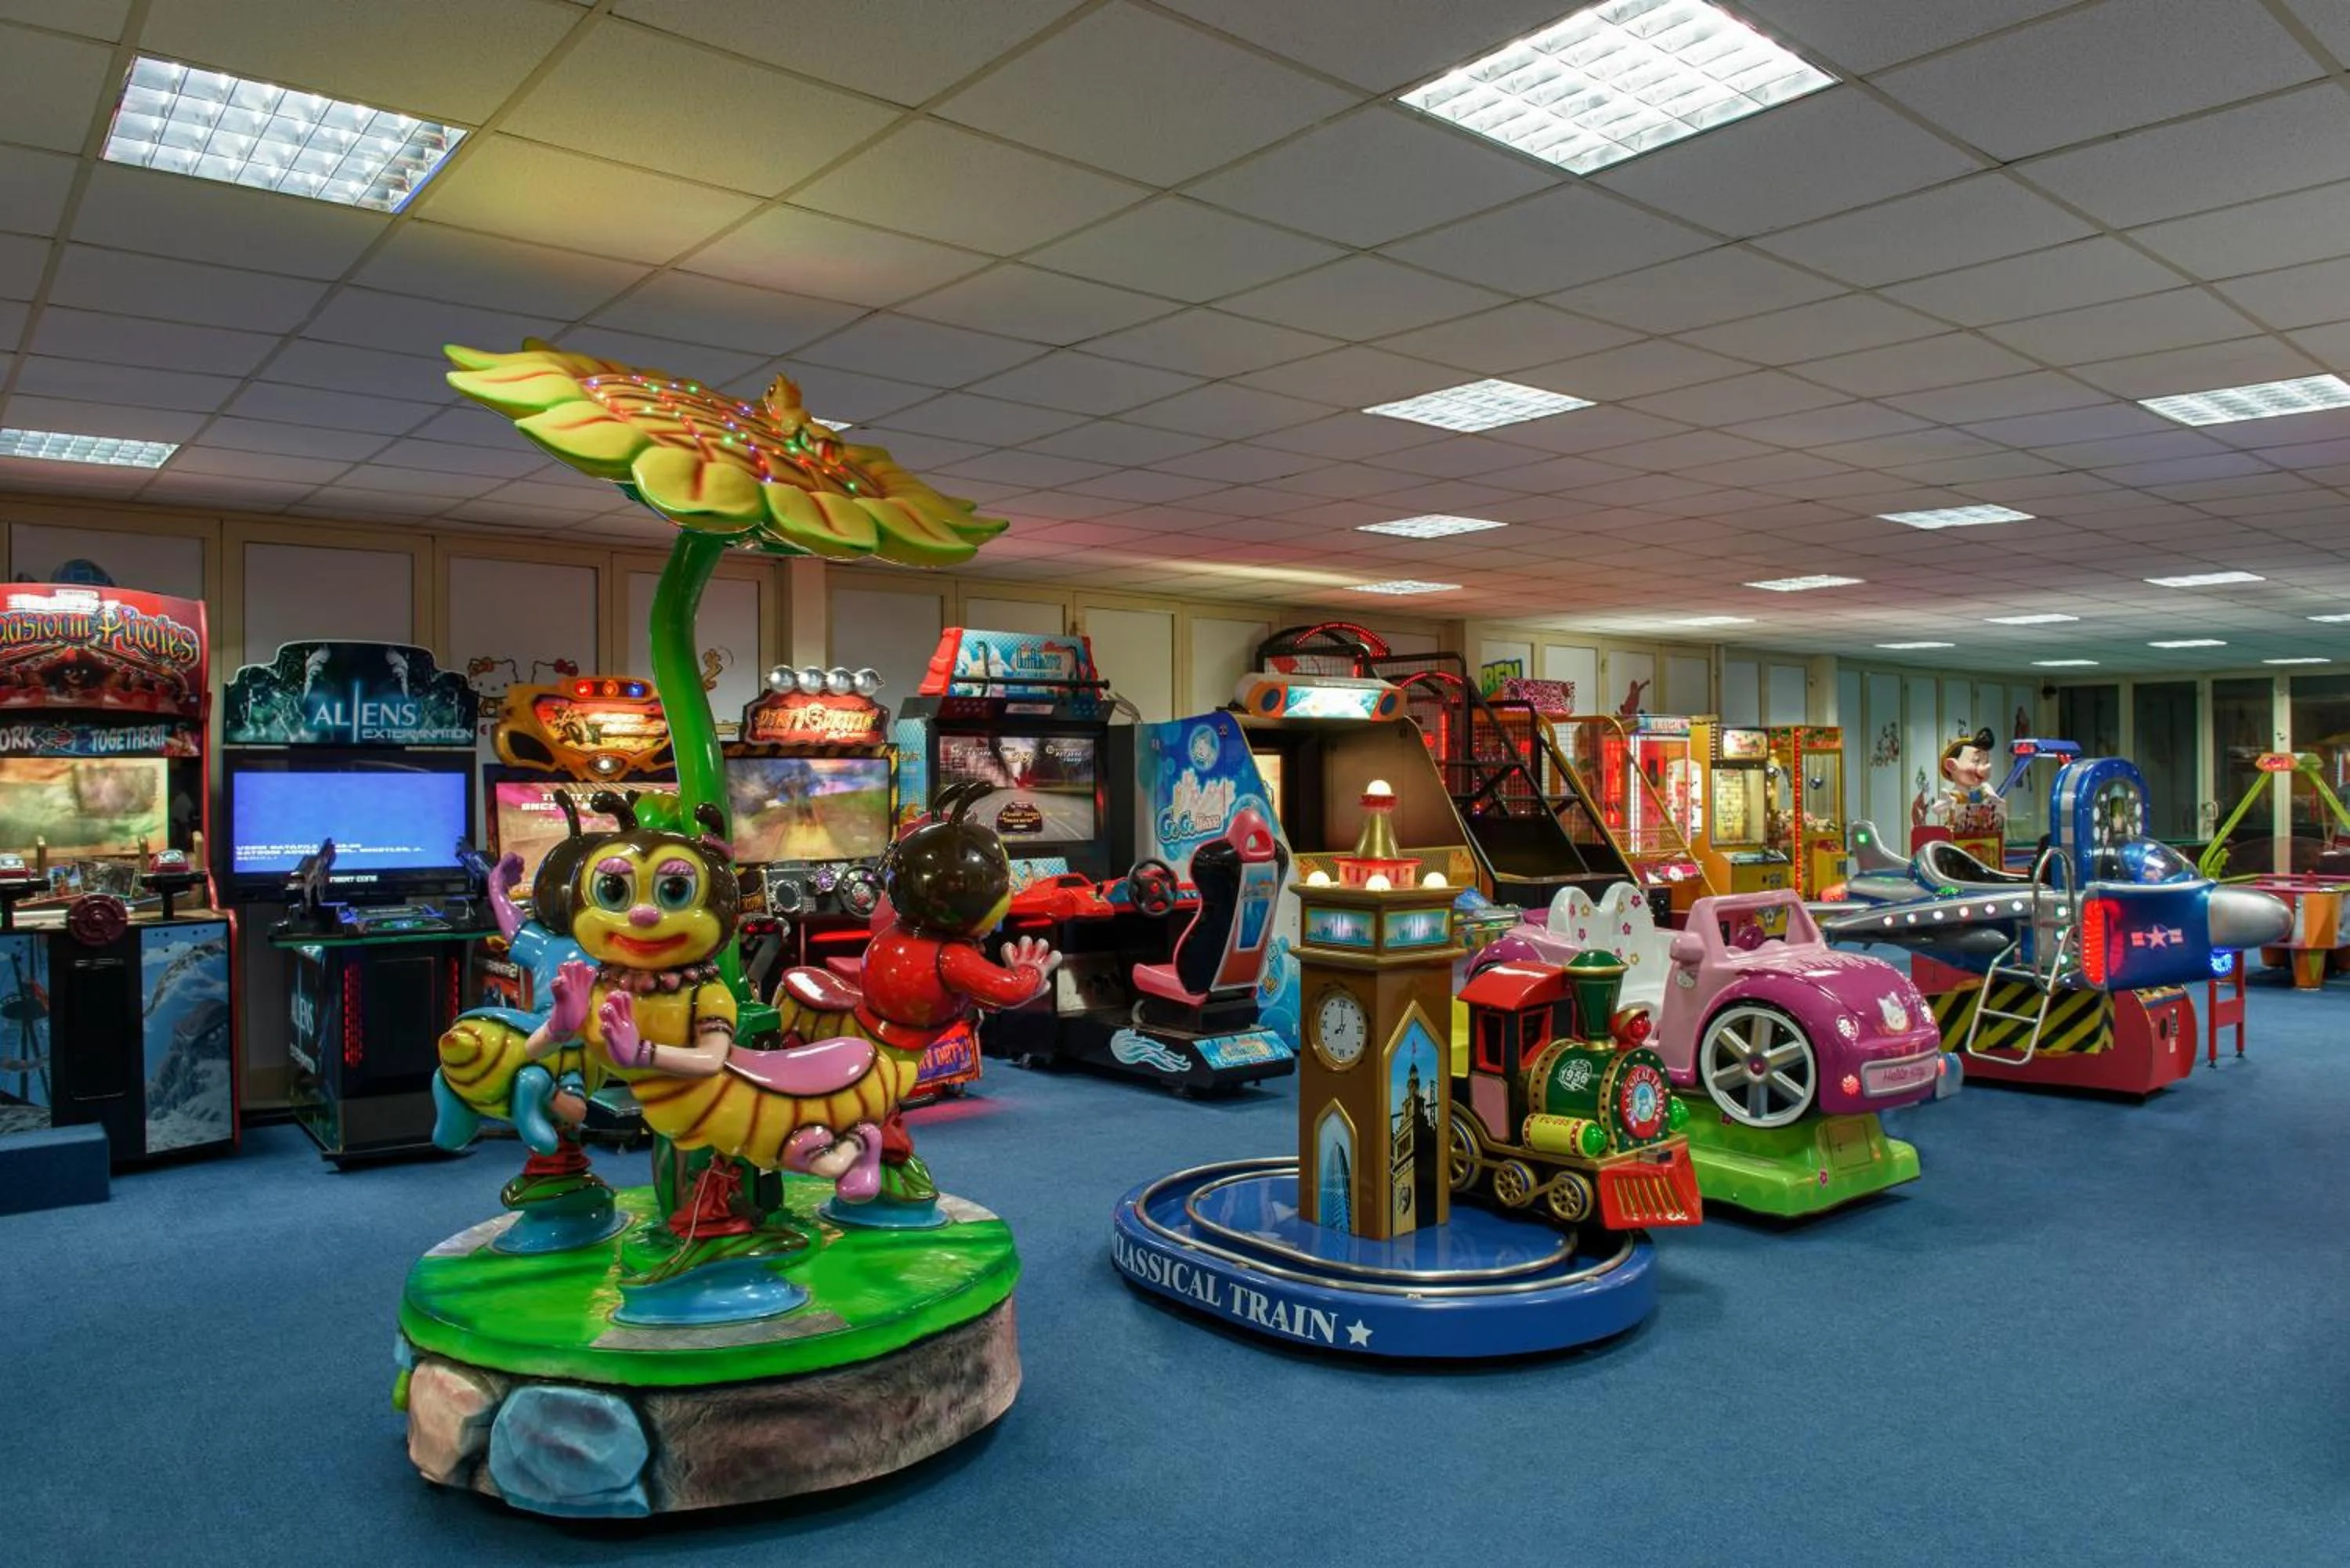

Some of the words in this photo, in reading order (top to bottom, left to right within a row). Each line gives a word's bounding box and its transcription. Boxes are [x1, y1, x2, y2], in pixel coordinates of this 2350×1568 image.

[97, 607, 196, 663] Pirates
[0, 726, 36, 751] ORK
[362, 728, 474, 739] EXTERMINATION
[1561, 1069, 1589, 1086] 1956
[1115, 1232, 1221, 1307] CLASSICAL
[1228, 1281, 1340, 1344] TRAIN
